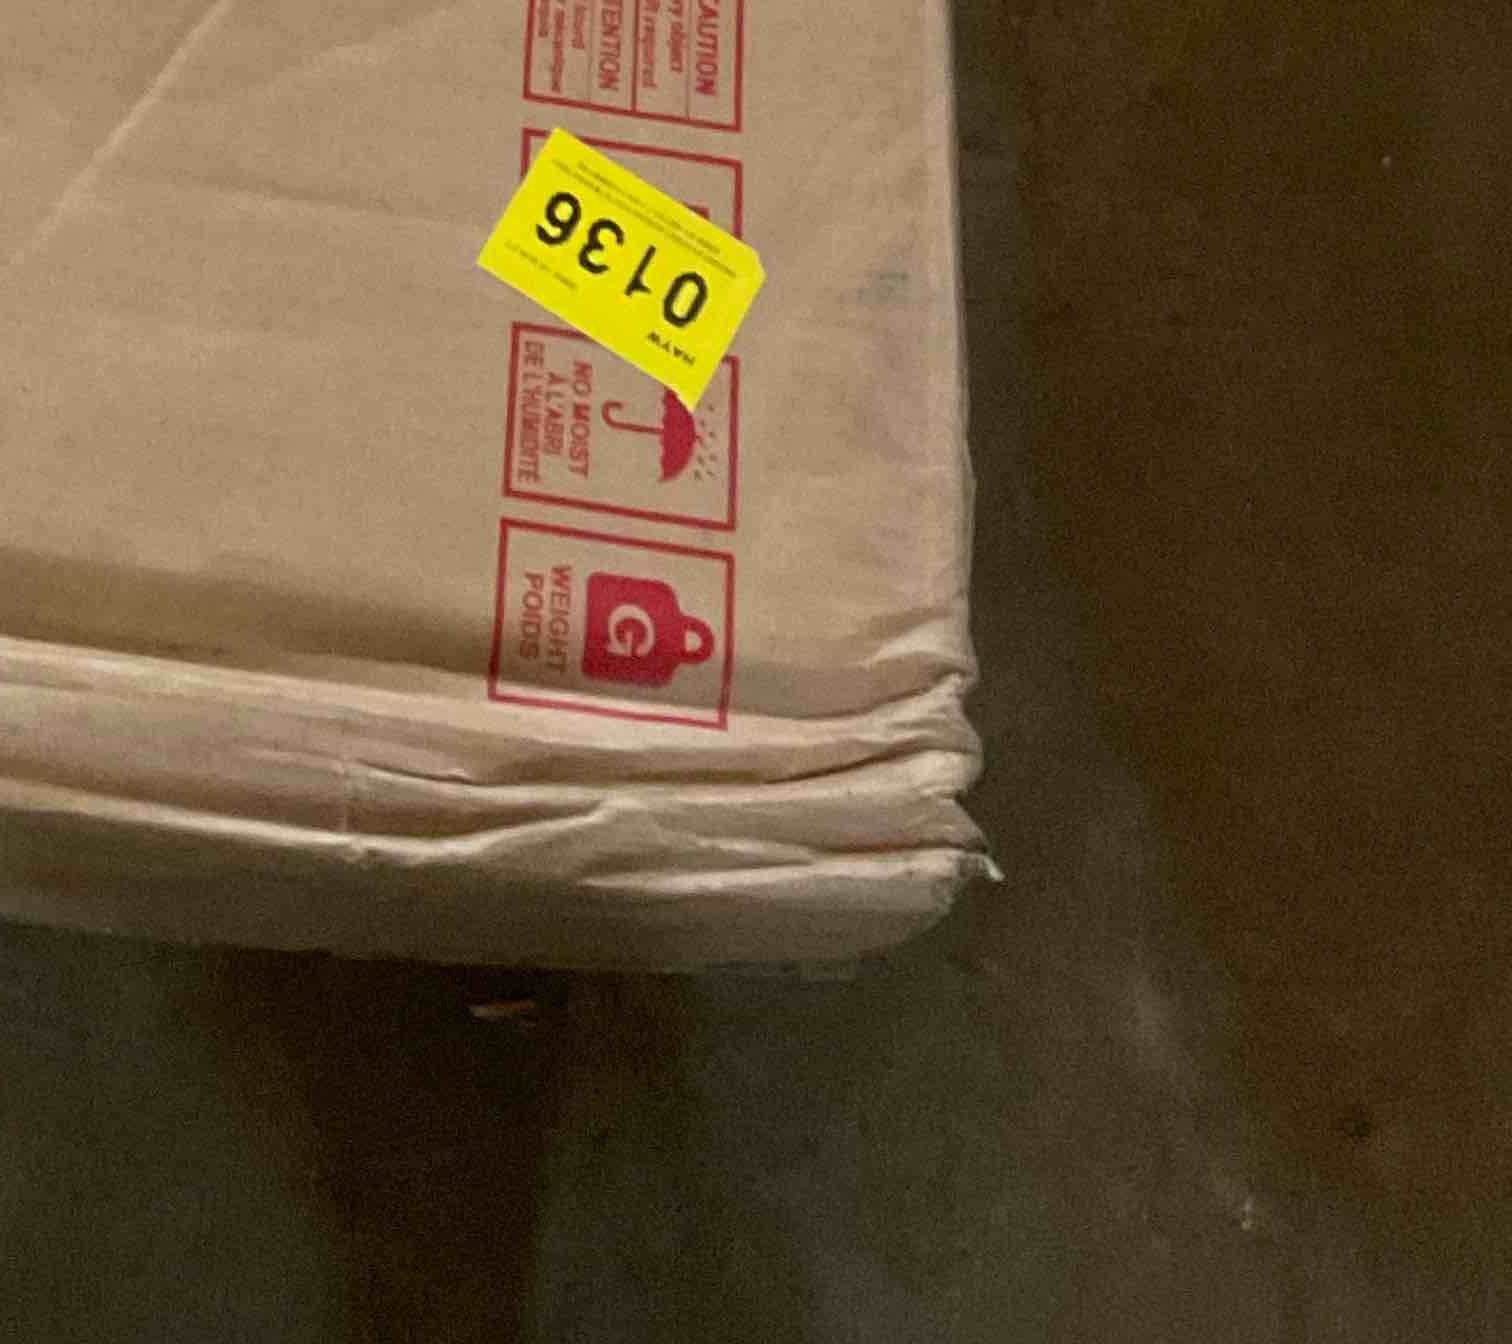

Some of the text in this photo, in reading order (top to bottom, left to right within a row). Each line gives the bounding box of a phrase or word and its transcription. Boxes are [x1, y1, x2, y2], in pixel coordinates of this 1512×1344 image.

[533, 191, 708, 330] 0136
[524, 338, 545, 368] DE
[567, 360, 593, 482] NO MOIST
[518, 571, 546, 663] POIDS
[545, 563, 574, 676] WEIGHT
